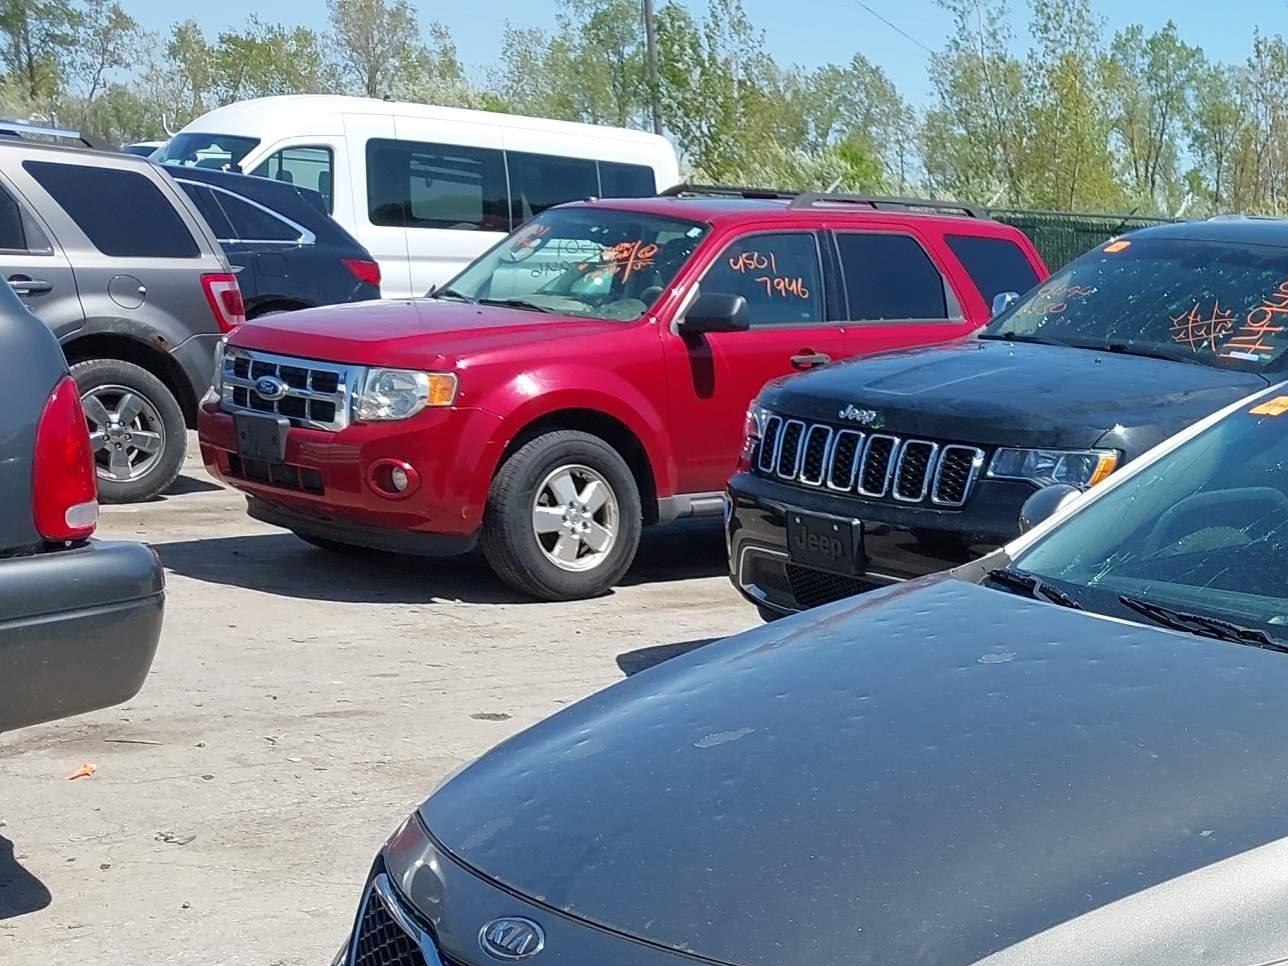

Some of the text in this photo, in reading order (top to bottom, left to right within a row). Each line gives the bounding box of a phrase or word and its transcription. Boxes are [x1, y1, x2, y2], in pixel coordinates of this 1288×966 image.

[729, 252, 776, 275] 4501
[755, 276, 809, 299] 7946
[839, 404, 877, 425] Jeep
[796, 525, 843, 559] Jeep
